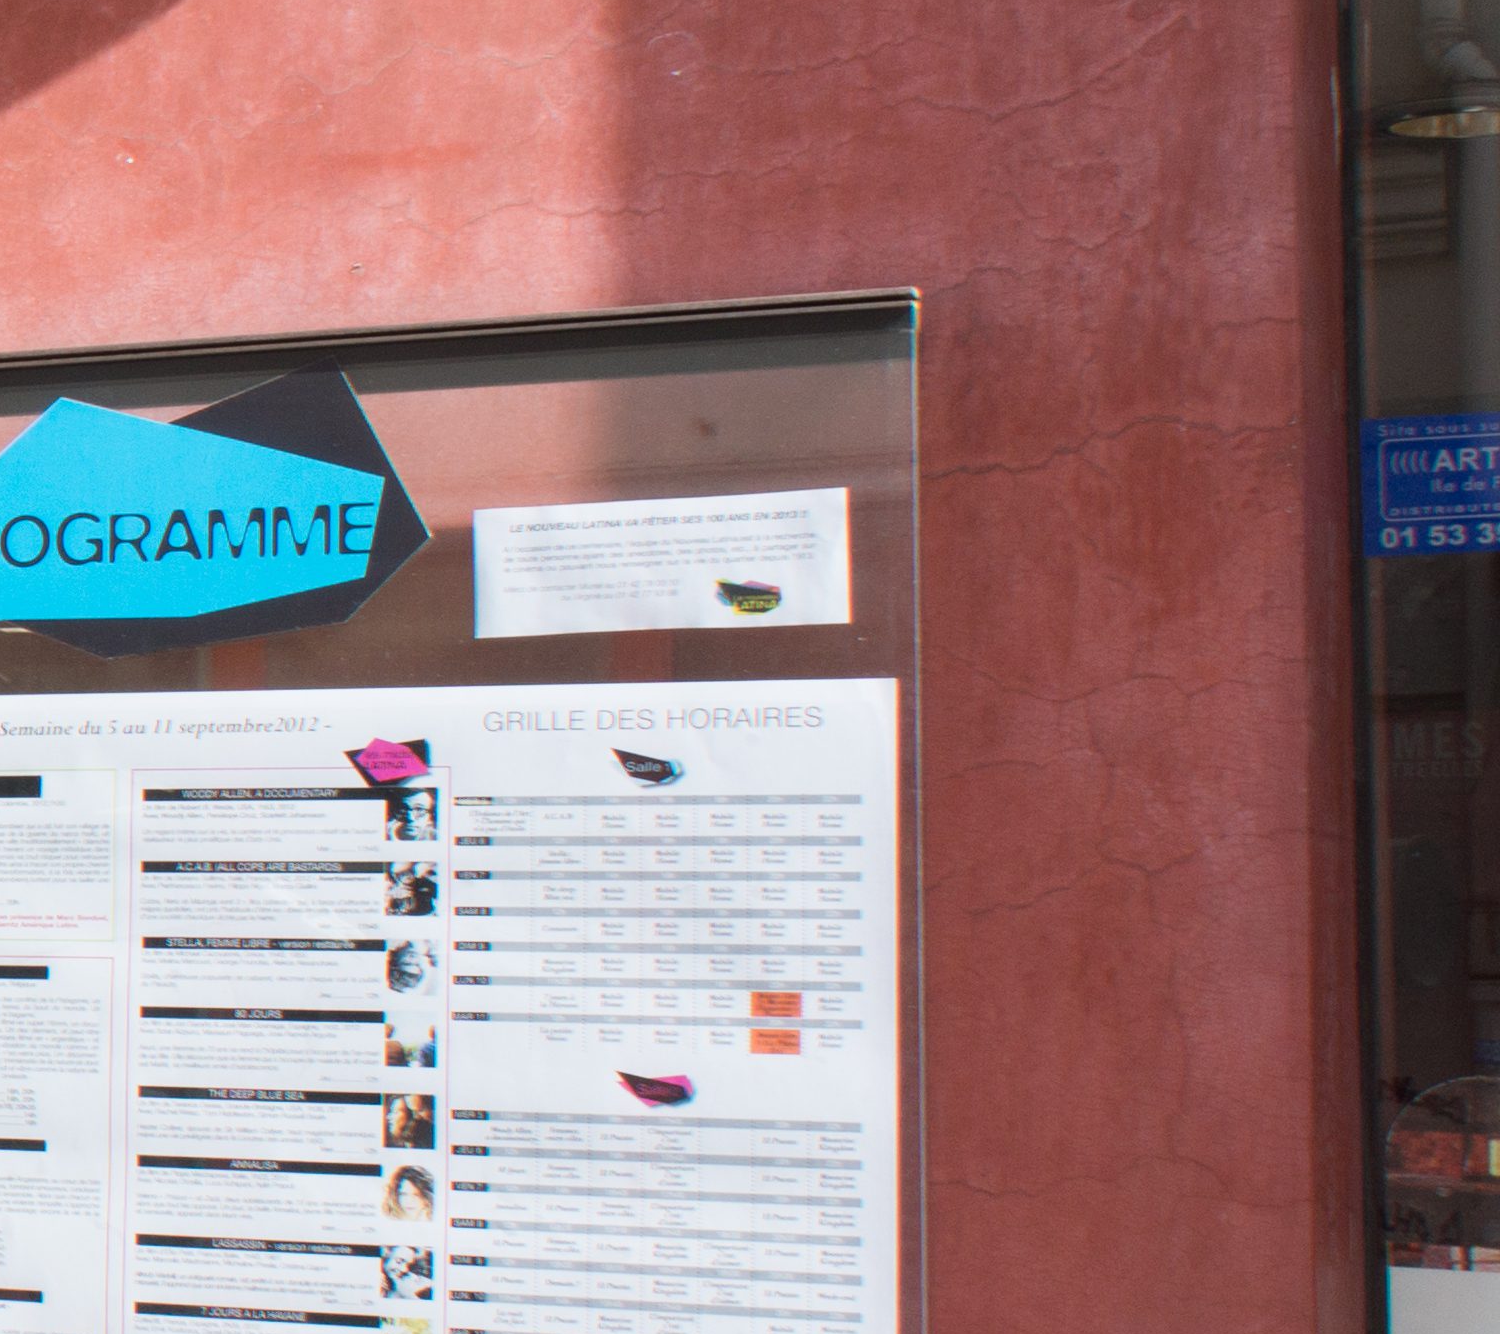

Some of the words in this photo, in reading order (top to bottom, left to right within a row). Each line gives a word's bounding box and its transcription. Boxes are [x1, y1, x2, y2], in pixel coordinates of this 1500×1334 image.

[1380, 527, 1419, 549] 01
[1428, 525, 1466, 547] 53
[78, 720, 101, 735] du
[108, 720, 117, 733] 5
[122, 723, 146, 735] au
[152, 719, 172, 734] 11
[178, 717, 319, 739] septembre2012
[483, 711, 586, 731] GRILLE
[597, 709, 652, 730] DES
[666, 707, 822, 729] HORAIRES
[625, 761, 661, 773] Salle
